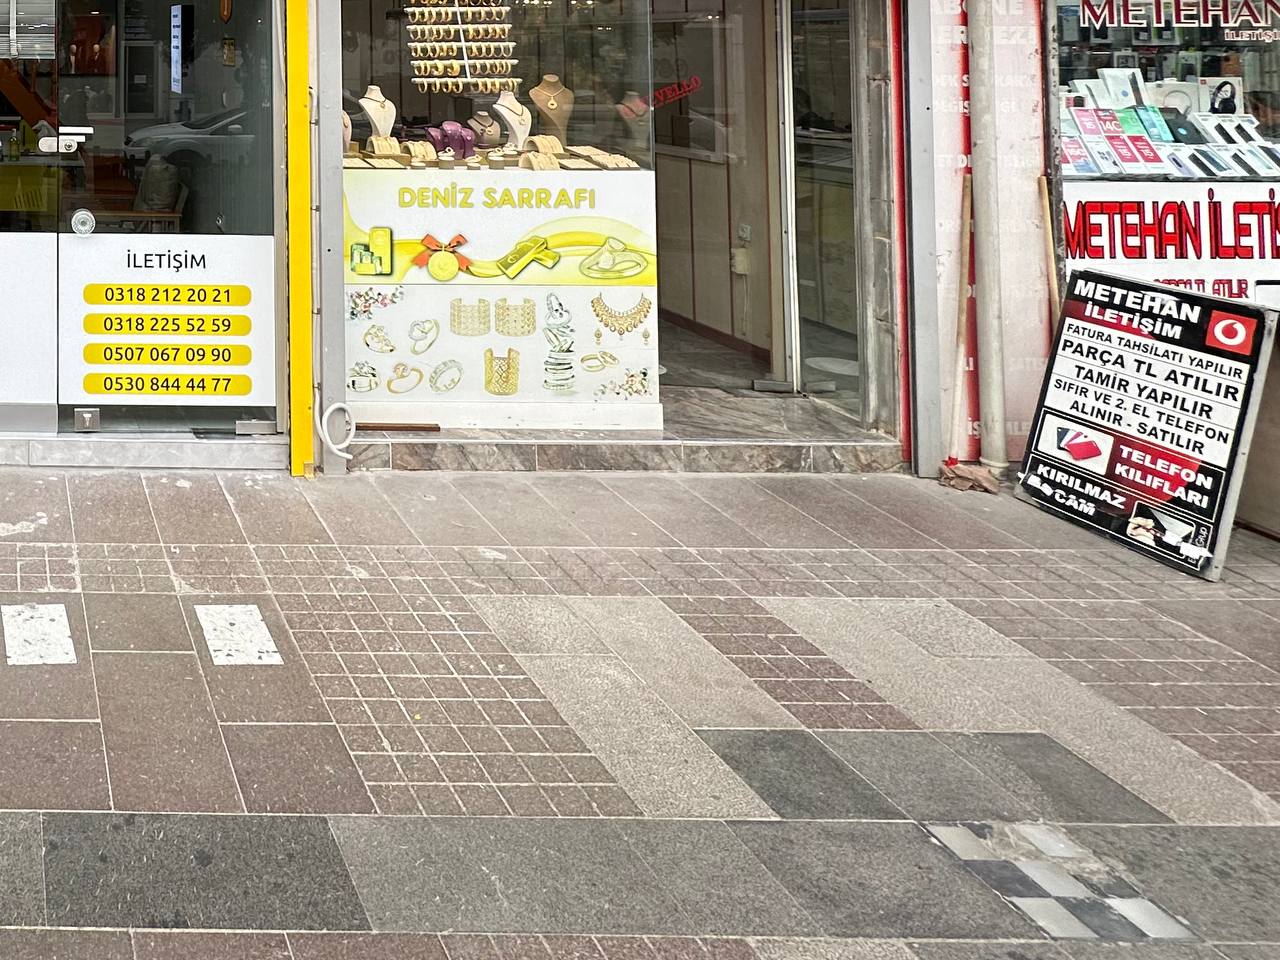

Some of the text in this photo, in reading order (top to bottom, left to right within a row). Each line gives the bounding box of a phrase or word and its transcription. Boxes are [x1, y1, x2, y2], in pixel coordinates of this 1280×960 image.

[398, 181, 596, 210] DENİZ SARRAFI
[1063, 187, 1280, 260] METEHAN İLETİ
[126, 249, 207, 273] İLETİŞİM
[104, 287, 231, 303] 0318 212 20 21
[1073, 279, 1202, 324] METEHAN
[103, 317, 231, 333] 0318 225 52 59
[1083, 300, 1183, 340] İLETİŞİM
[103, 347, 231, 362] 0507 067 09 90
[1061, 338, 1126, 369] PARÇA
[1133, 358, 1157, 378] TL
[1164, 369, 1240, 402] ATILIR
[1066, 323, 1243, 380] FATURA TAHSİLATI YAPILIR
[103, 377, 232, 392] 0530 844 44 77
[1074, 364, 1214, 420] TAMİR YAPILIR
[1053, 378, 1230, 444] SIFIR VE 2. EL TELEFON
[1070, 400, 1123, 427] ALINIR
[1136, 422, 1205, 455] SATILIR
[1037, 464, 1128, 509] KIRILMAZ
[1114, 463, 1210, 509] KILIFLARI
[1120, 445, 1214, 490] TELEFON
[1054, 489, 1096, 517] CAM
